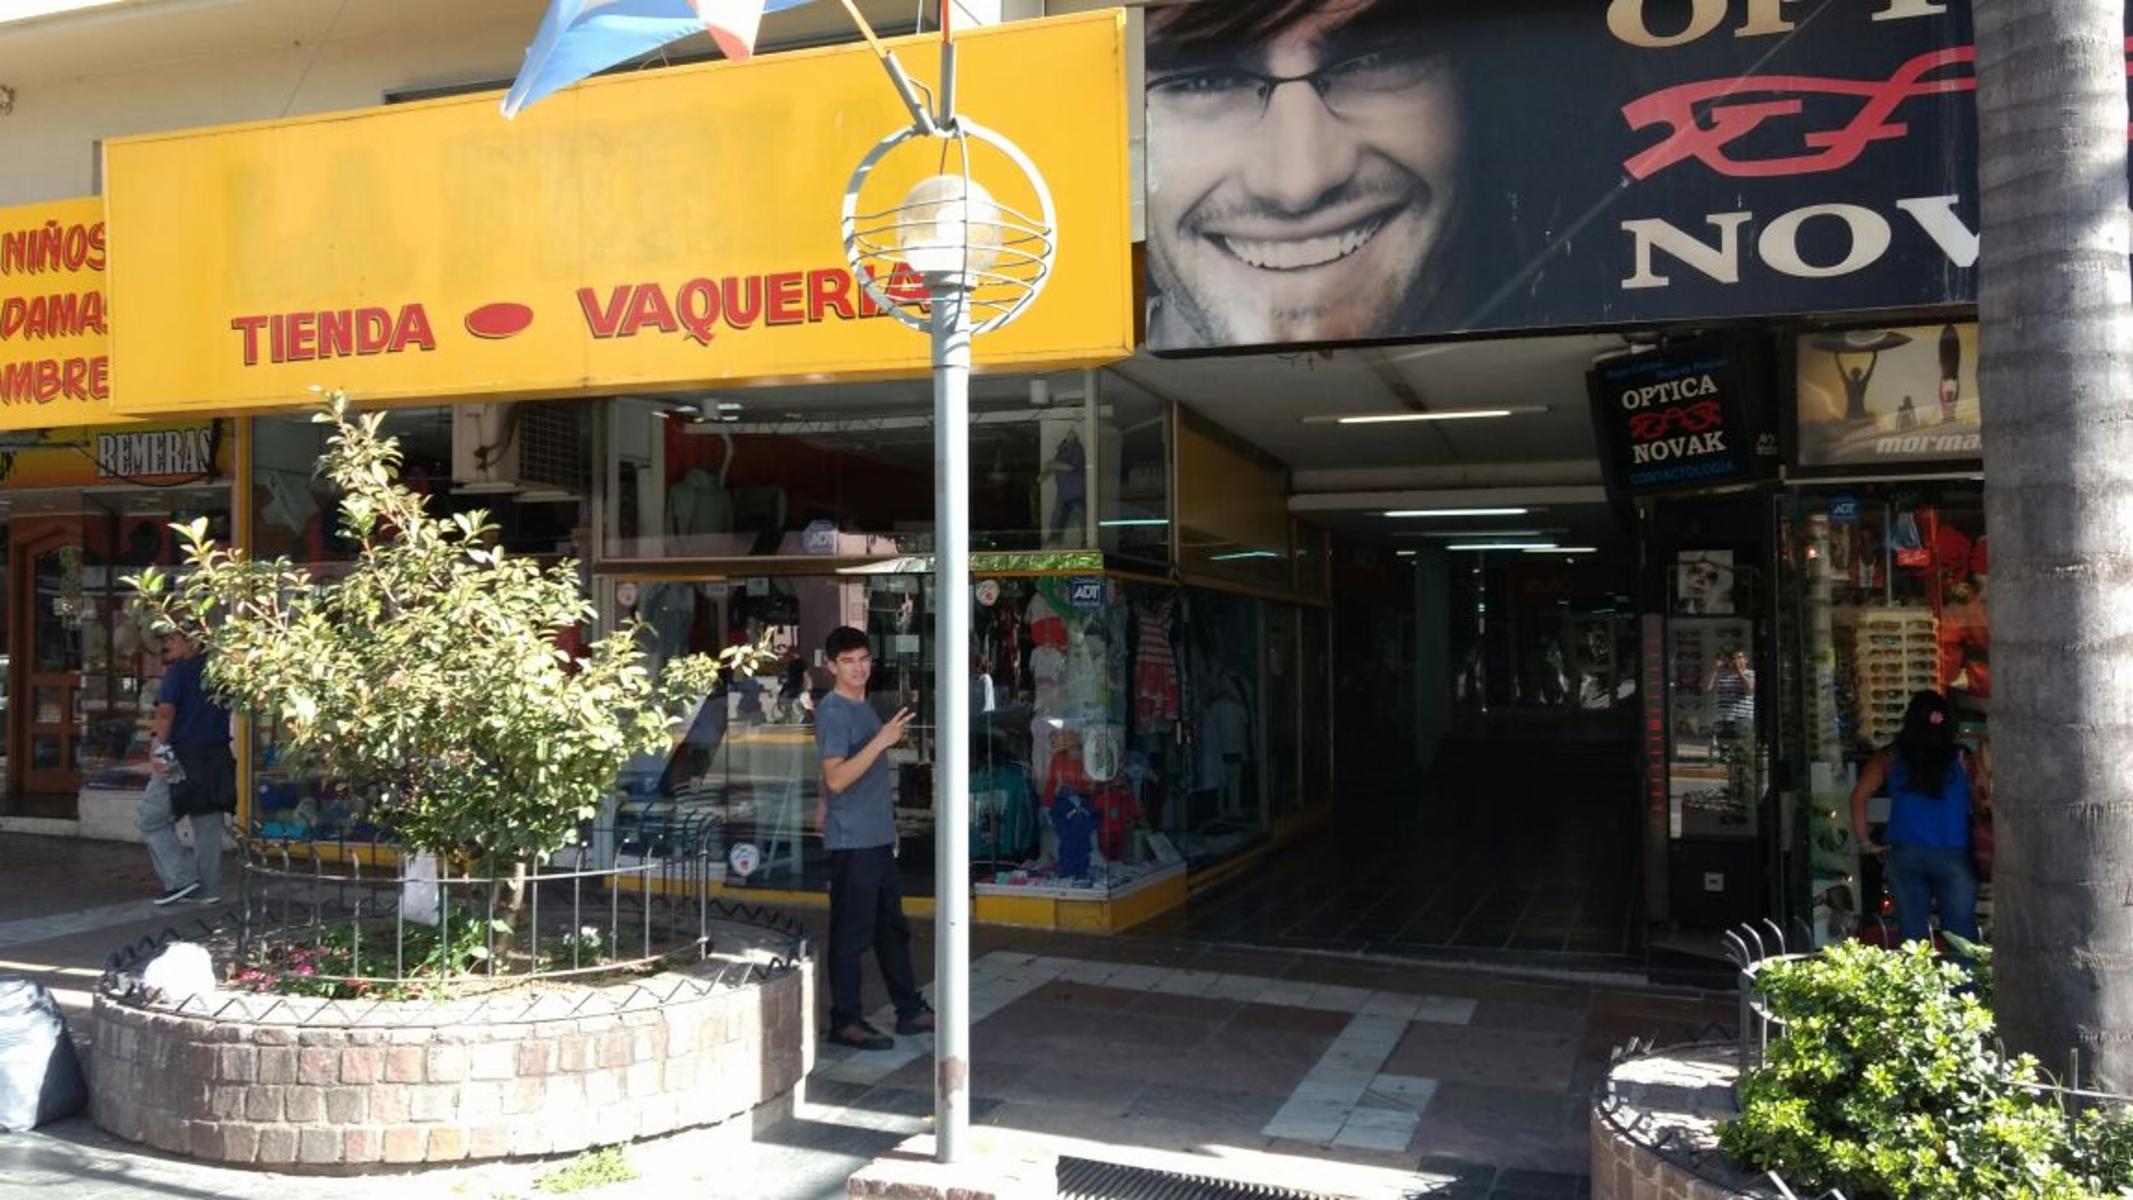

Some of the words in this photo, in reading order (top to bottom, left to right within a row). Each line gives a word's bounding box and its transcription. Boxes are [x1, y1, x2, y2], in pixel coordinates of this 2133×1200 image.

[1, 220, 105, 275] NIÑOS
[0, 291, 108, 341] DAMA
[231, 303, 436, 365] TIENDA
[577, 261, 933, 347] VAQUERIA
[1622, 374, 1718, 409] OPTICA
[97, 428, 213, 476] REMERAS
[1632, 431, 1727, 463] NOVAK
[1072, 584, 1101, 599] ADT
